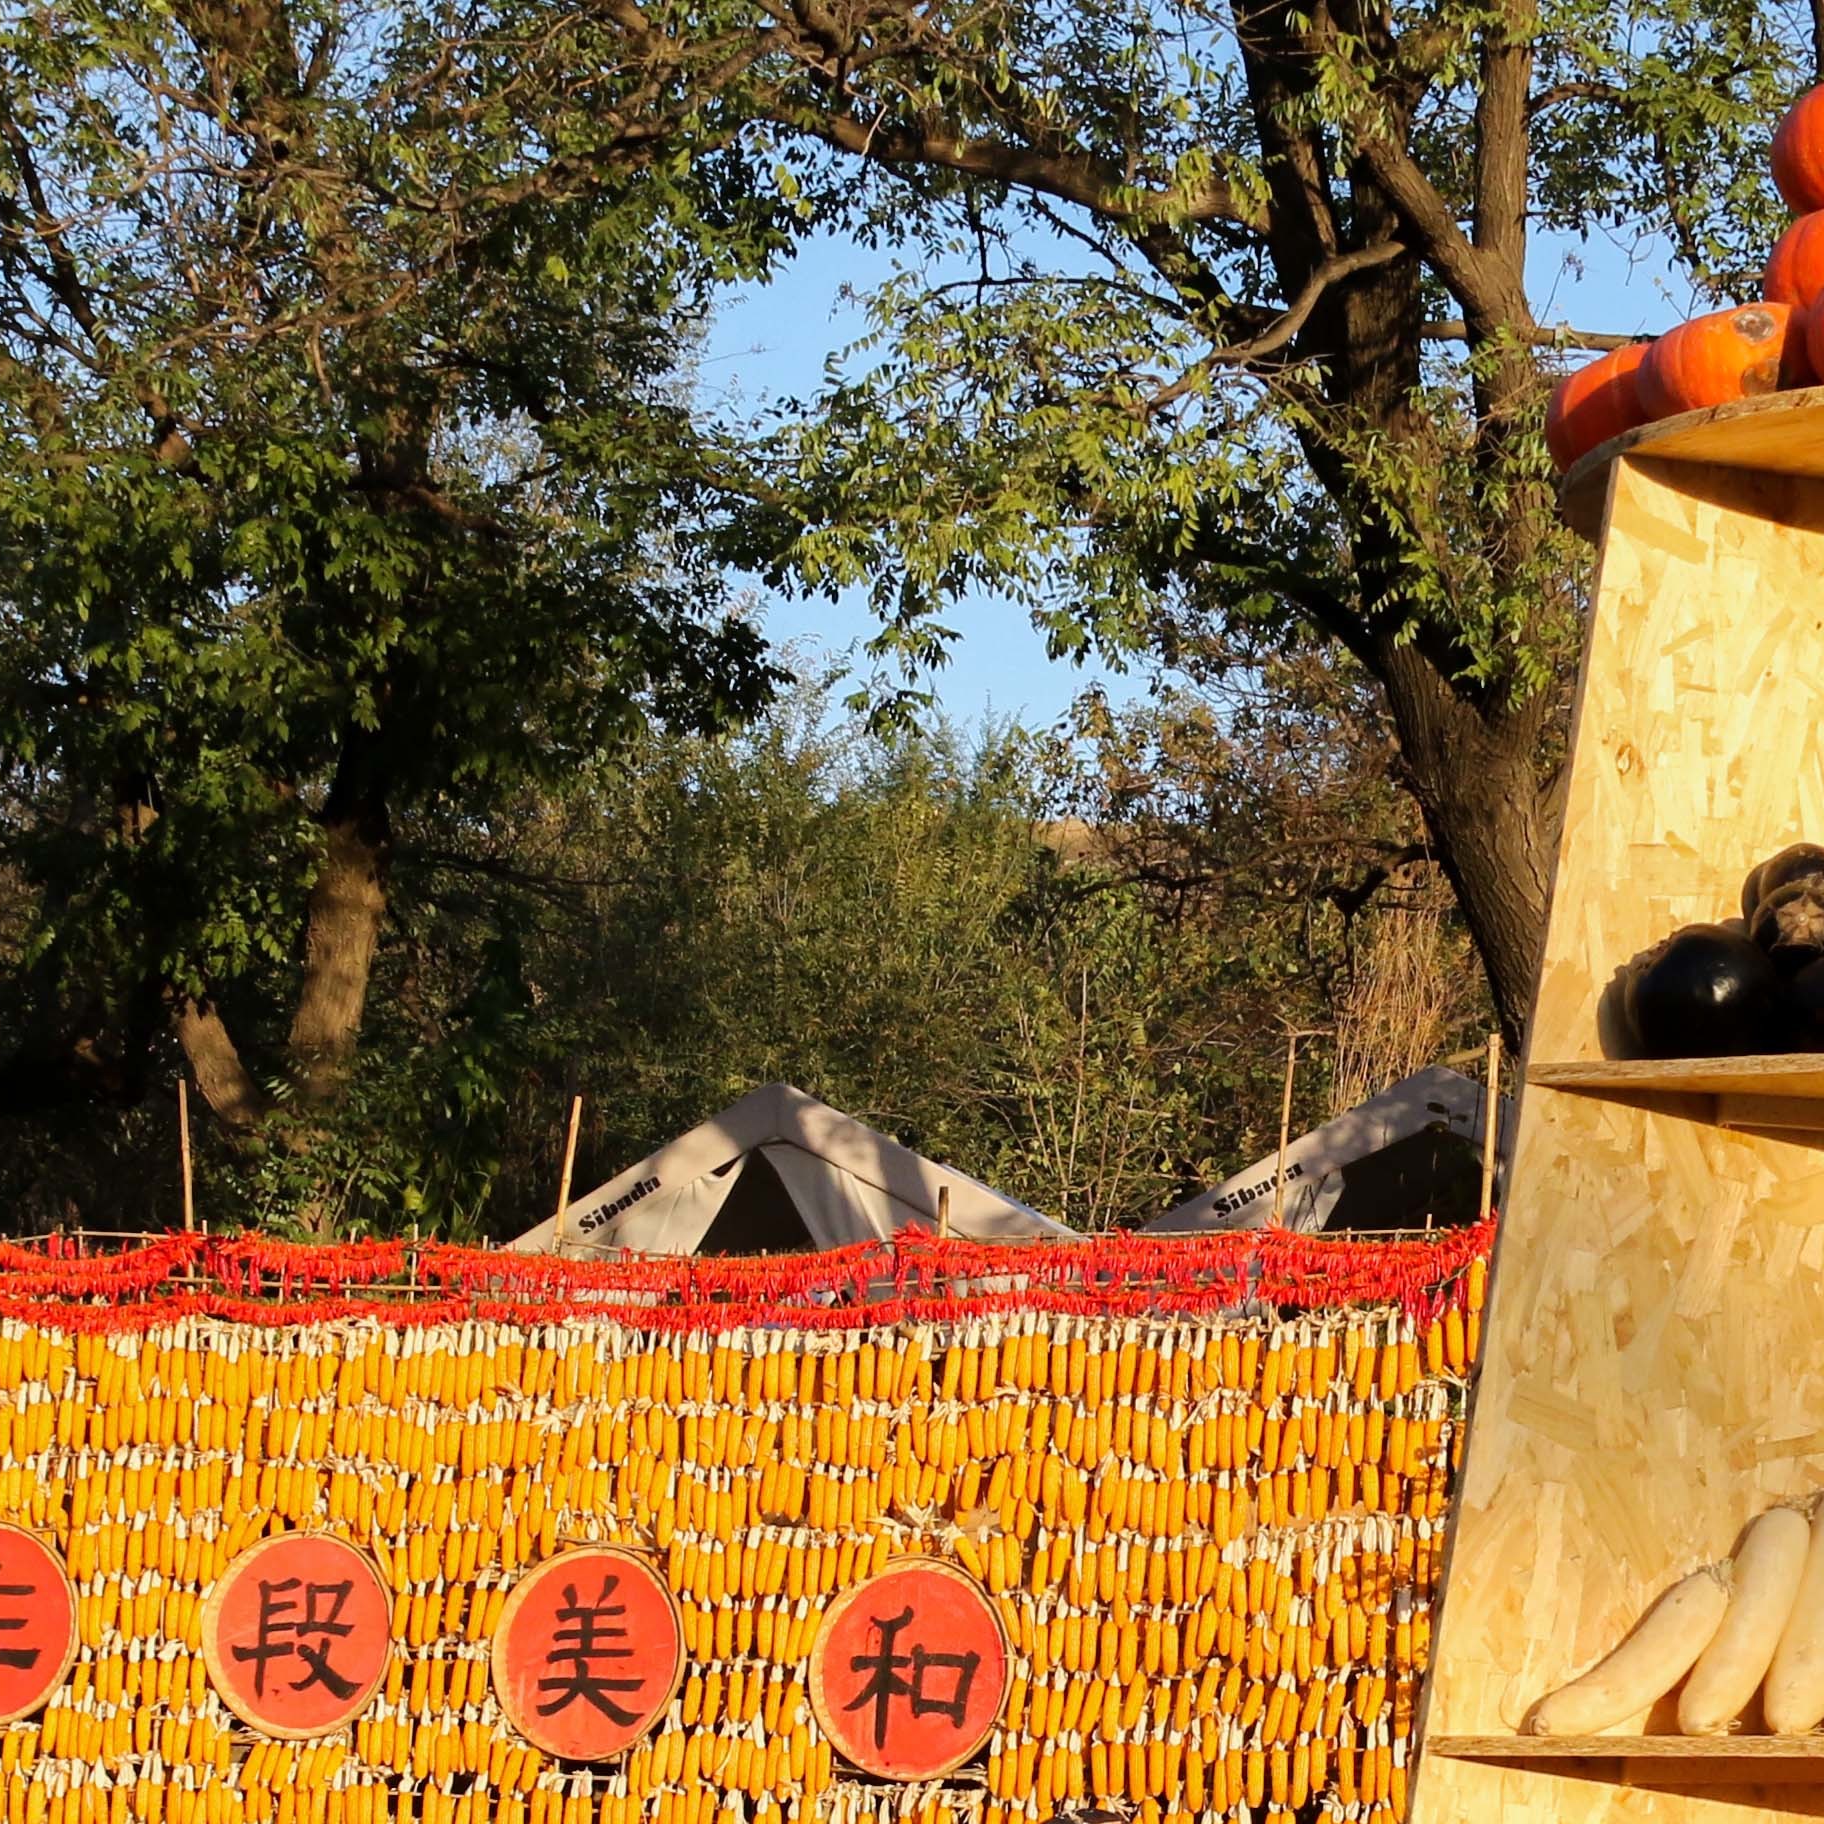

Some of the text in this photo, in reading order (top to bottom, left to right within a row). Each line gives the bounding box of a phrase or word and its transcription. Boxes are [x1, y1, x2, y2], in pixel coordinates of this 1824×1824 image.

[231, 1577, 364, 1700] 段
[536, 1573, 648, 1730] 美
[846, 1604, 980, 1749] 和
